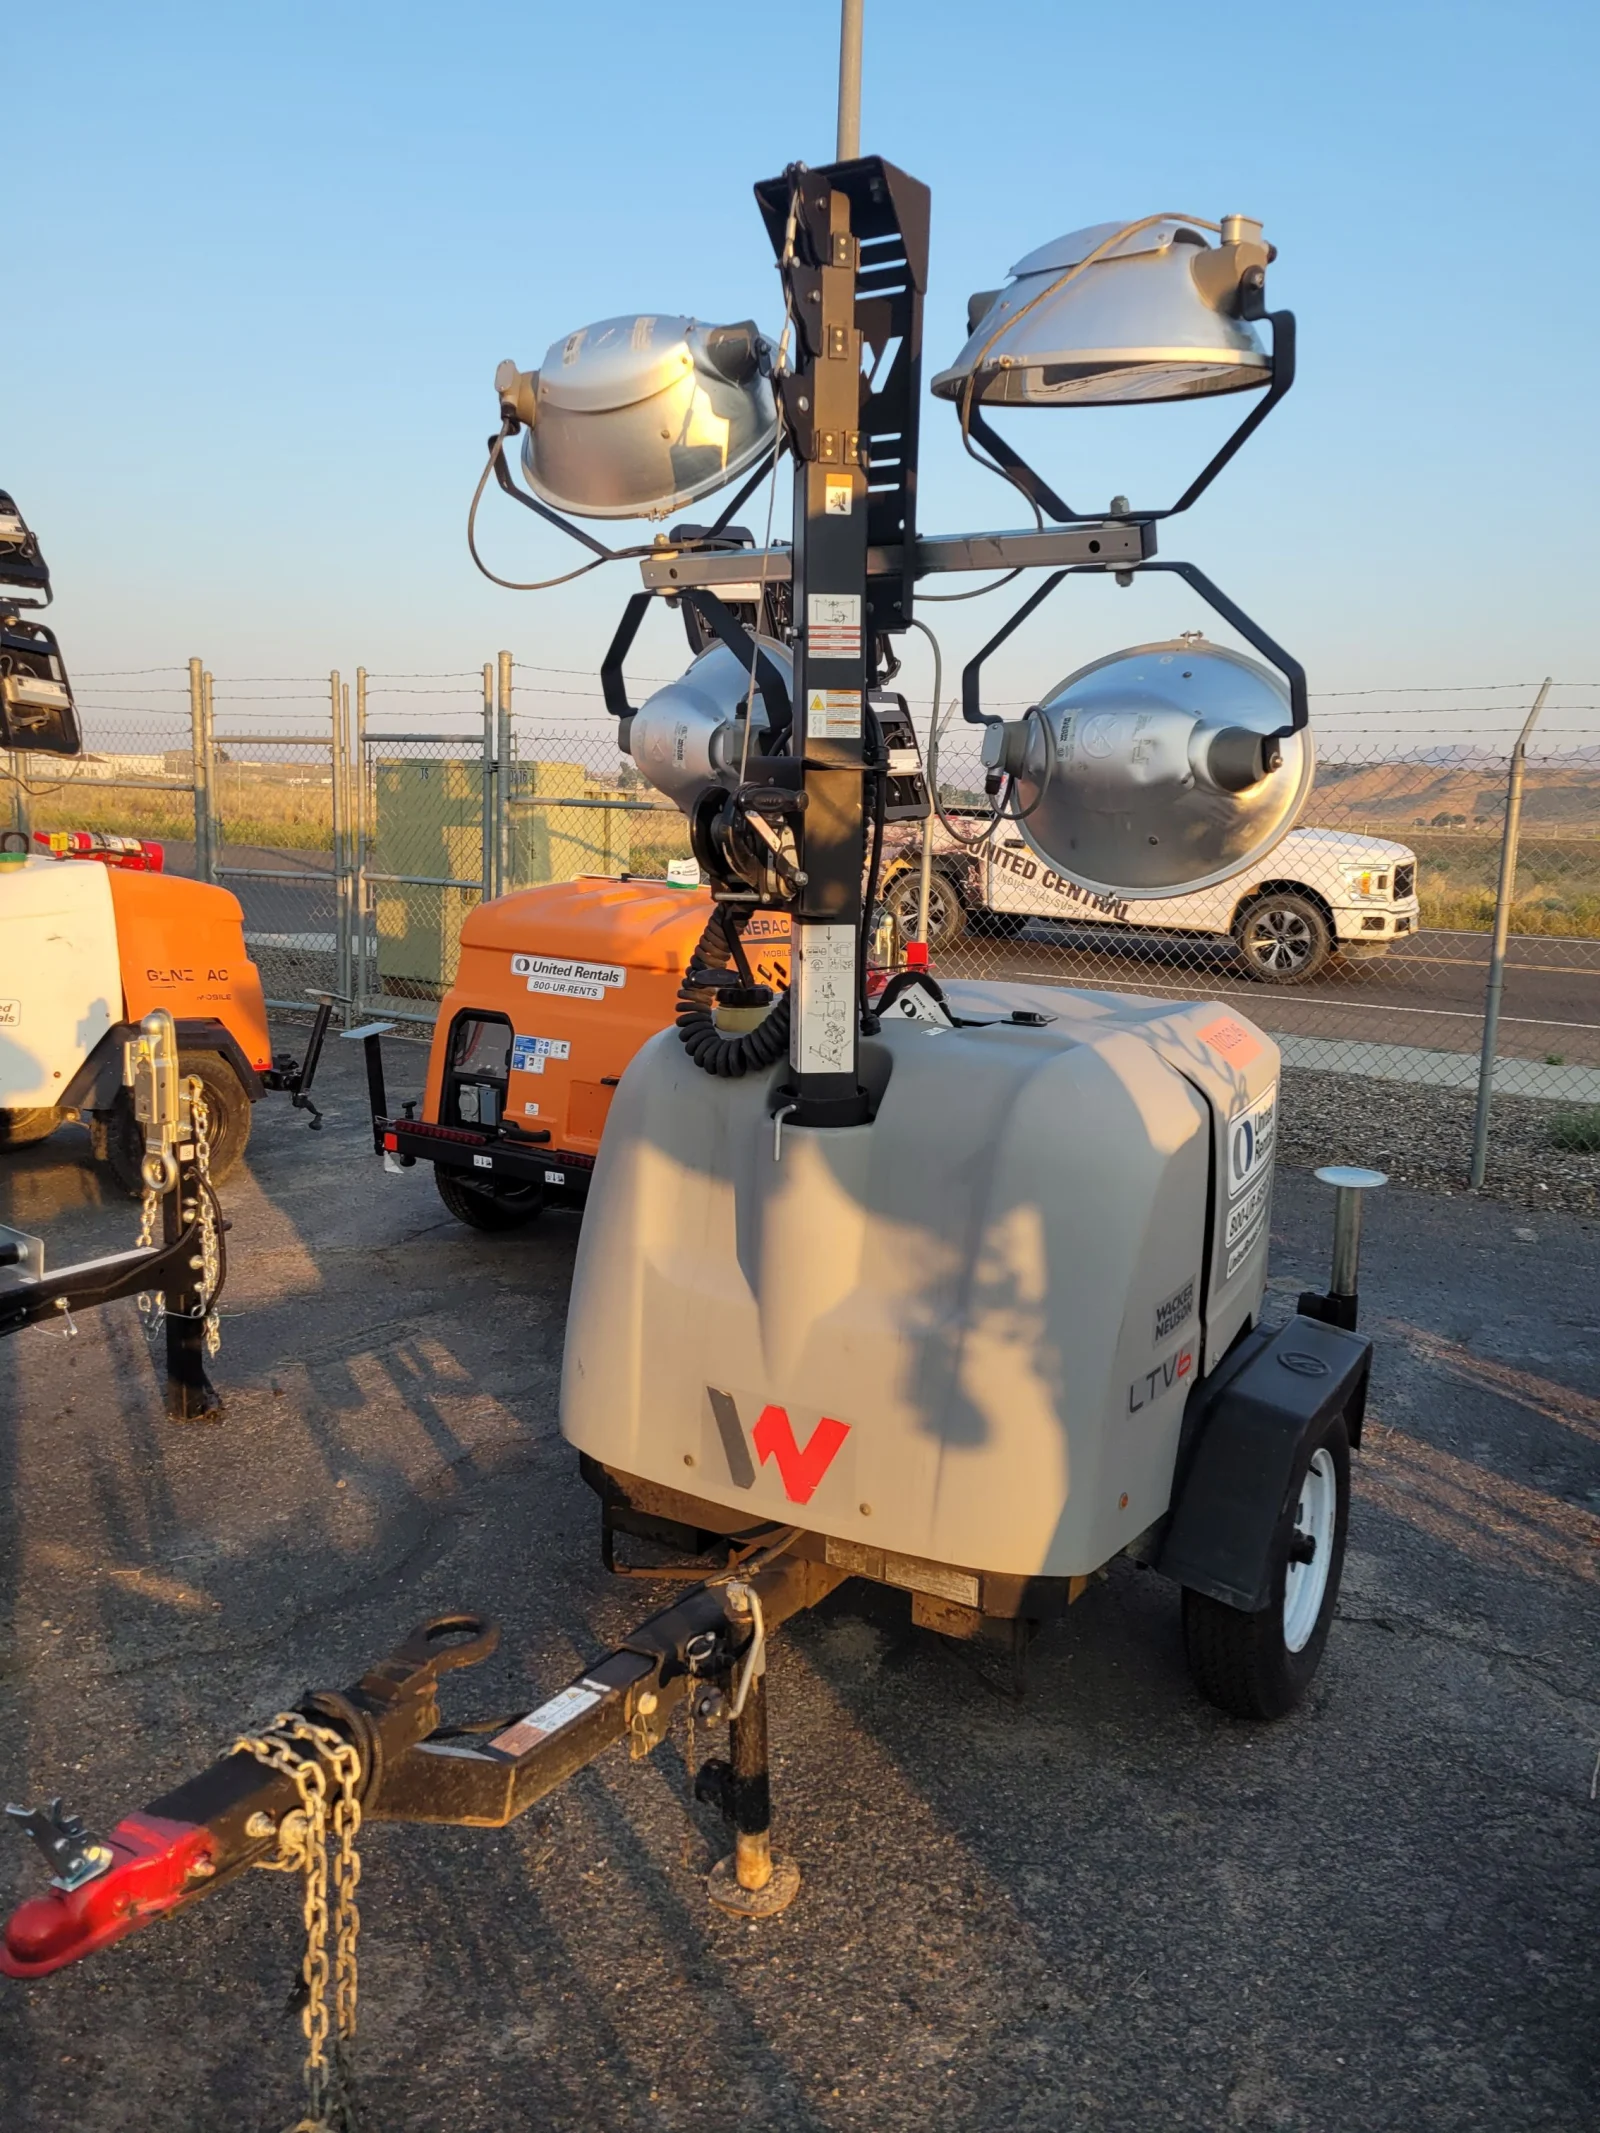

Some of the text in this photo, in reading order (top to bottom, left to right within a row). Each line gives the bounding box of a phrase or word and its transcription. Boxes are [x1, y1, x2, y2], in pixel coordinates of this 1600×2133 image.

[967, 840, 1131, 923] UNITED CENTRAL
[742, 919, 790, 936] NERAC
[763, 949, 792, 958] MOBILE
[532, 960, 620, 983] United Rentals
[533, 980, 598, 997] 800-UR-RENTS
[1156, 1283, 1193, 1322] WACKER
[1155, 1301, 1192, 1341] NEUSON
[1129, 1348, 1193, 1413] LTV6
